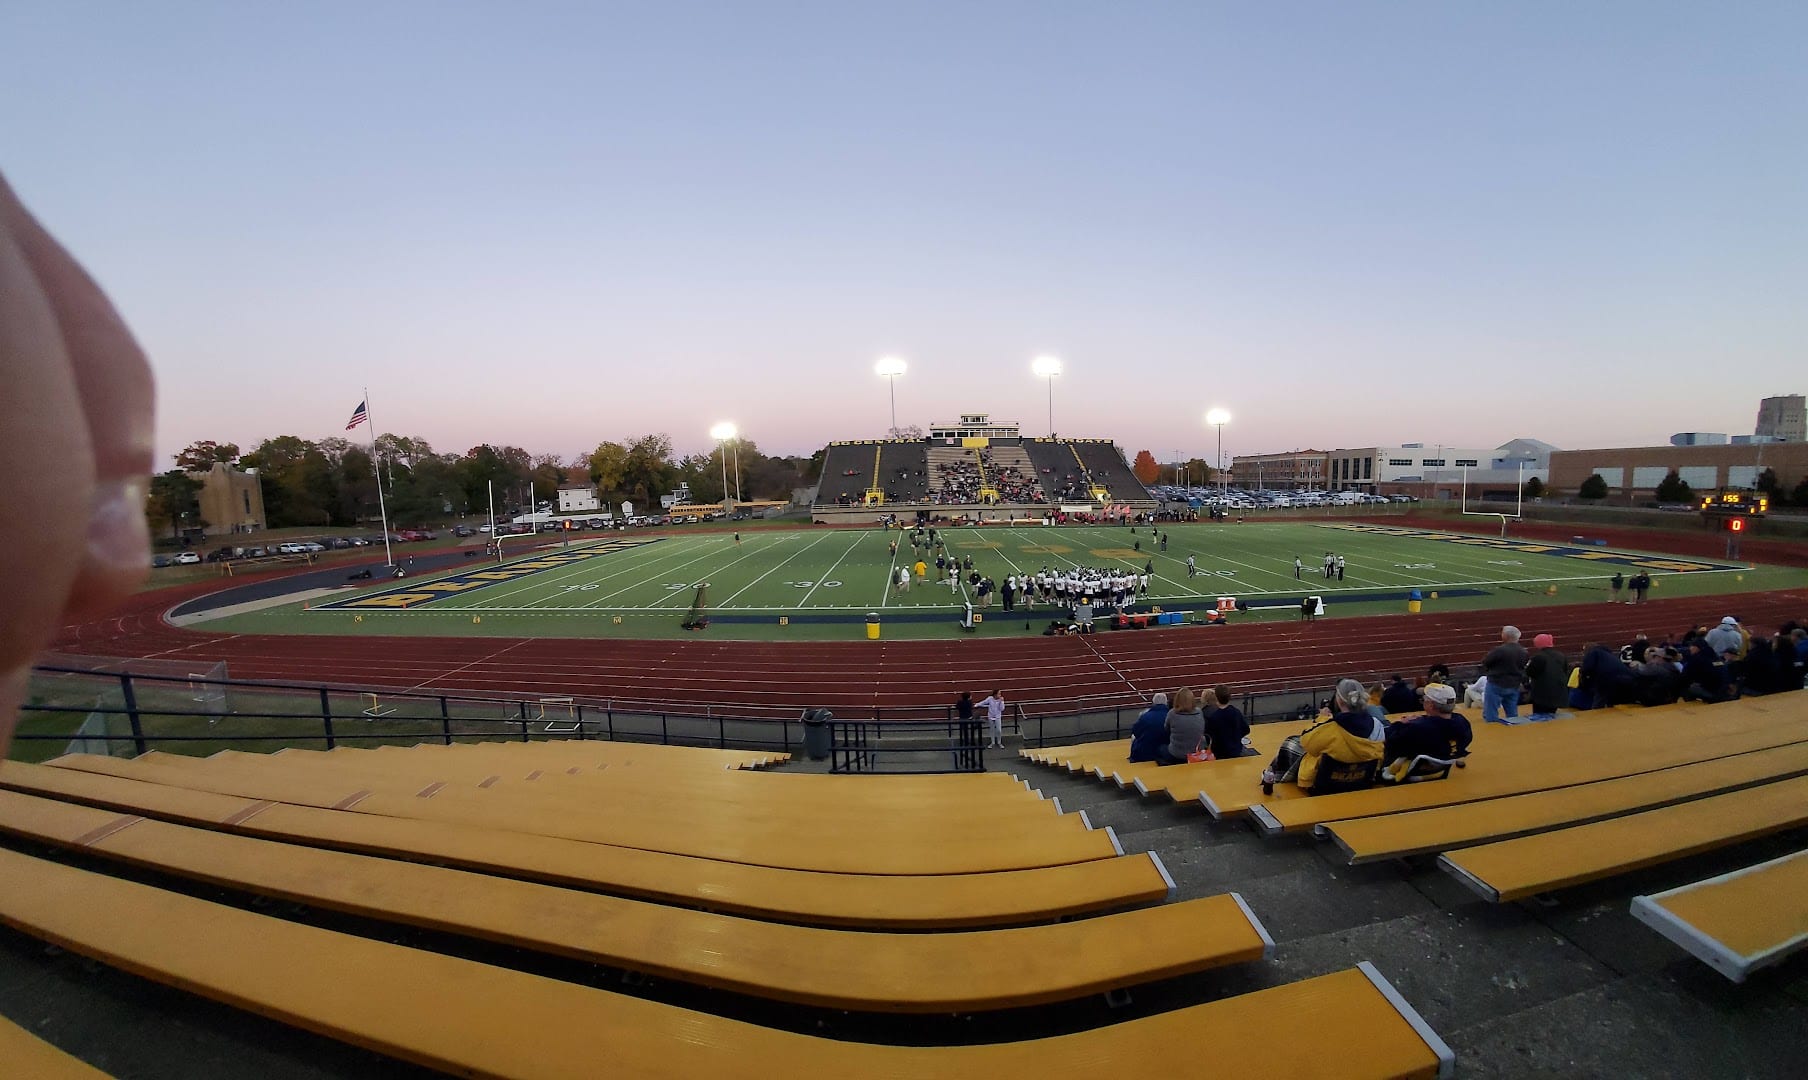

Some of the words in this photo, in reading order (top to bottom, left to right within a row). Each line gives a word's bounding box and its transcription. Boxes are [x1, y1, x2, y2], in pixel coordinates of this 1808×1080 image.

[853, 437, 926, 446] CENTRAL
[1732, 520, 1741, 530] 0
[793, 580, 843, 588] 30
